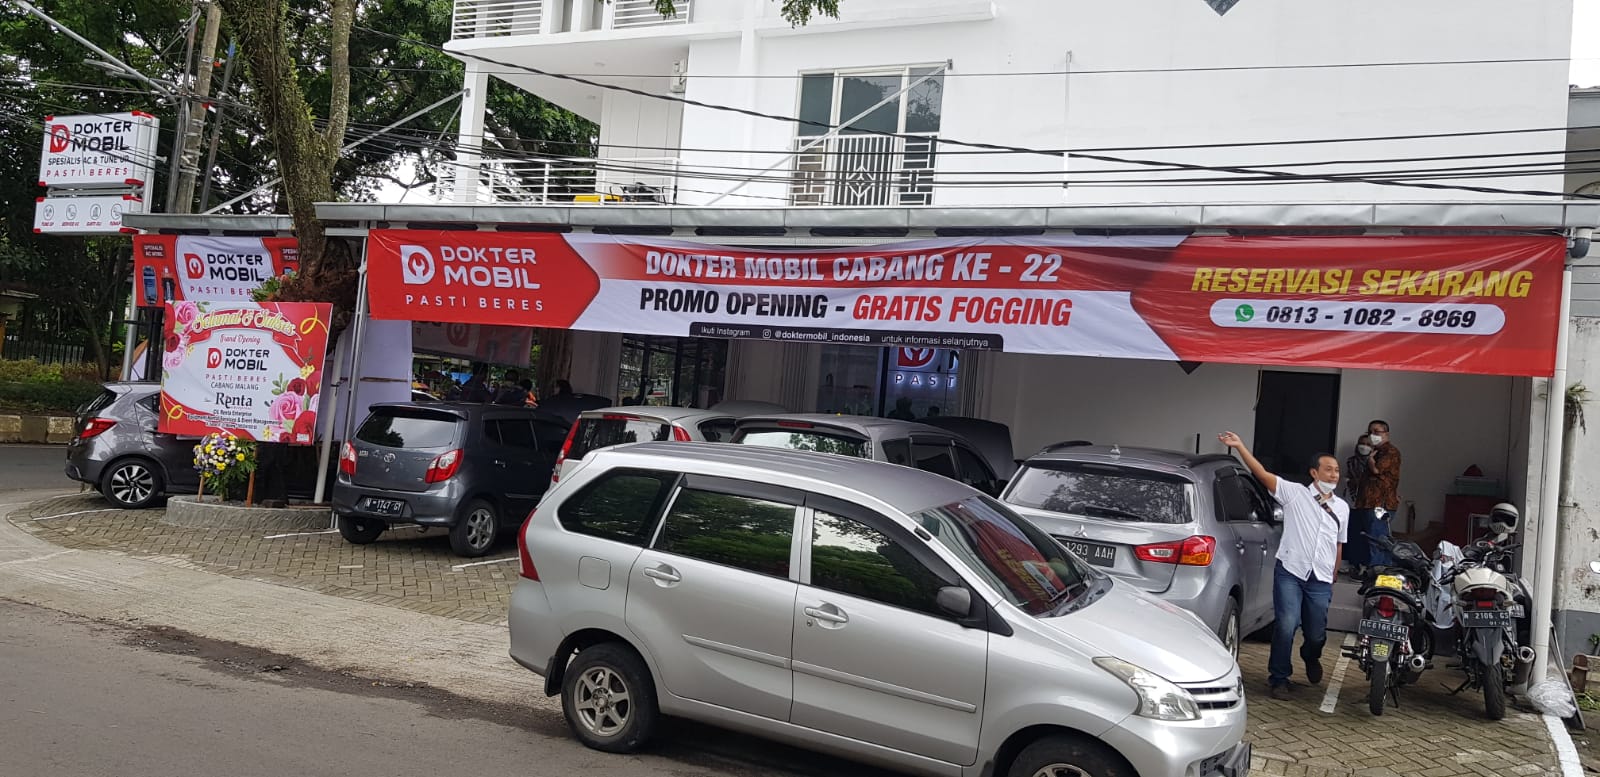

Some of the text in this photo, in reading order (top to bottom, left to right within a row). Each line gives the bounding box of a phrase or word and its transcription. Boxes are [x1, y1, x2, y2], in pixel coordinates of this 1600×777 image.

[74, 121, 132, 135] DOKTER
[72, 136, 129, 152] MOBIL
[48, 157, 80, 166] SPESIALIS
[100, 156, 118, 164] TUNE
[46, 168, 128, 178] PASTI BERES
[207, 254, 263, 266] DOKTER
[440, 246, 536, 264] DOKTER
[210, 266, 264, 282] MOBIL
[646, 251, 1063, 282] DOKTER MOBIL CABANG KE - 22
[443, 265, 540, 290] MOBIL
[1191, 267, 1534, 298] RESERVASI SEKARANG
[190, 286, 252, 296] PASTI BER
[406, 294, 544, 311] PASTI BERES
[640, 288, 720, 314] PROMO
[726, 291, 829, 318] OPENING
[852, 294, 942, 322] GRATIS
[948, 296, 1073, 326] FOGGING
[1266, 306, 1319, 324] 0813
[1342, 308, 1396, 326] 1082
[1418, 309, 1477, 329] 8969
[240, 334, 260, 345] Opening
[701, 326, 989, 348] Ikuti Instagram @doktermobil_indonesia untuk informasi selanjutnya
[226, 348, 270, 358] DOKTER
[224, 360, 268, 371] MOBIL
[211, 382, 234, 390] CABANG
[896, 374, 956, 388] PAST
[216, 392, 252, 408] Renta
[1066, 542, 1088, 556] 1293
[1094, 546, 1114, 560] AAH
[1475, 612, 1494, 620] 2106
